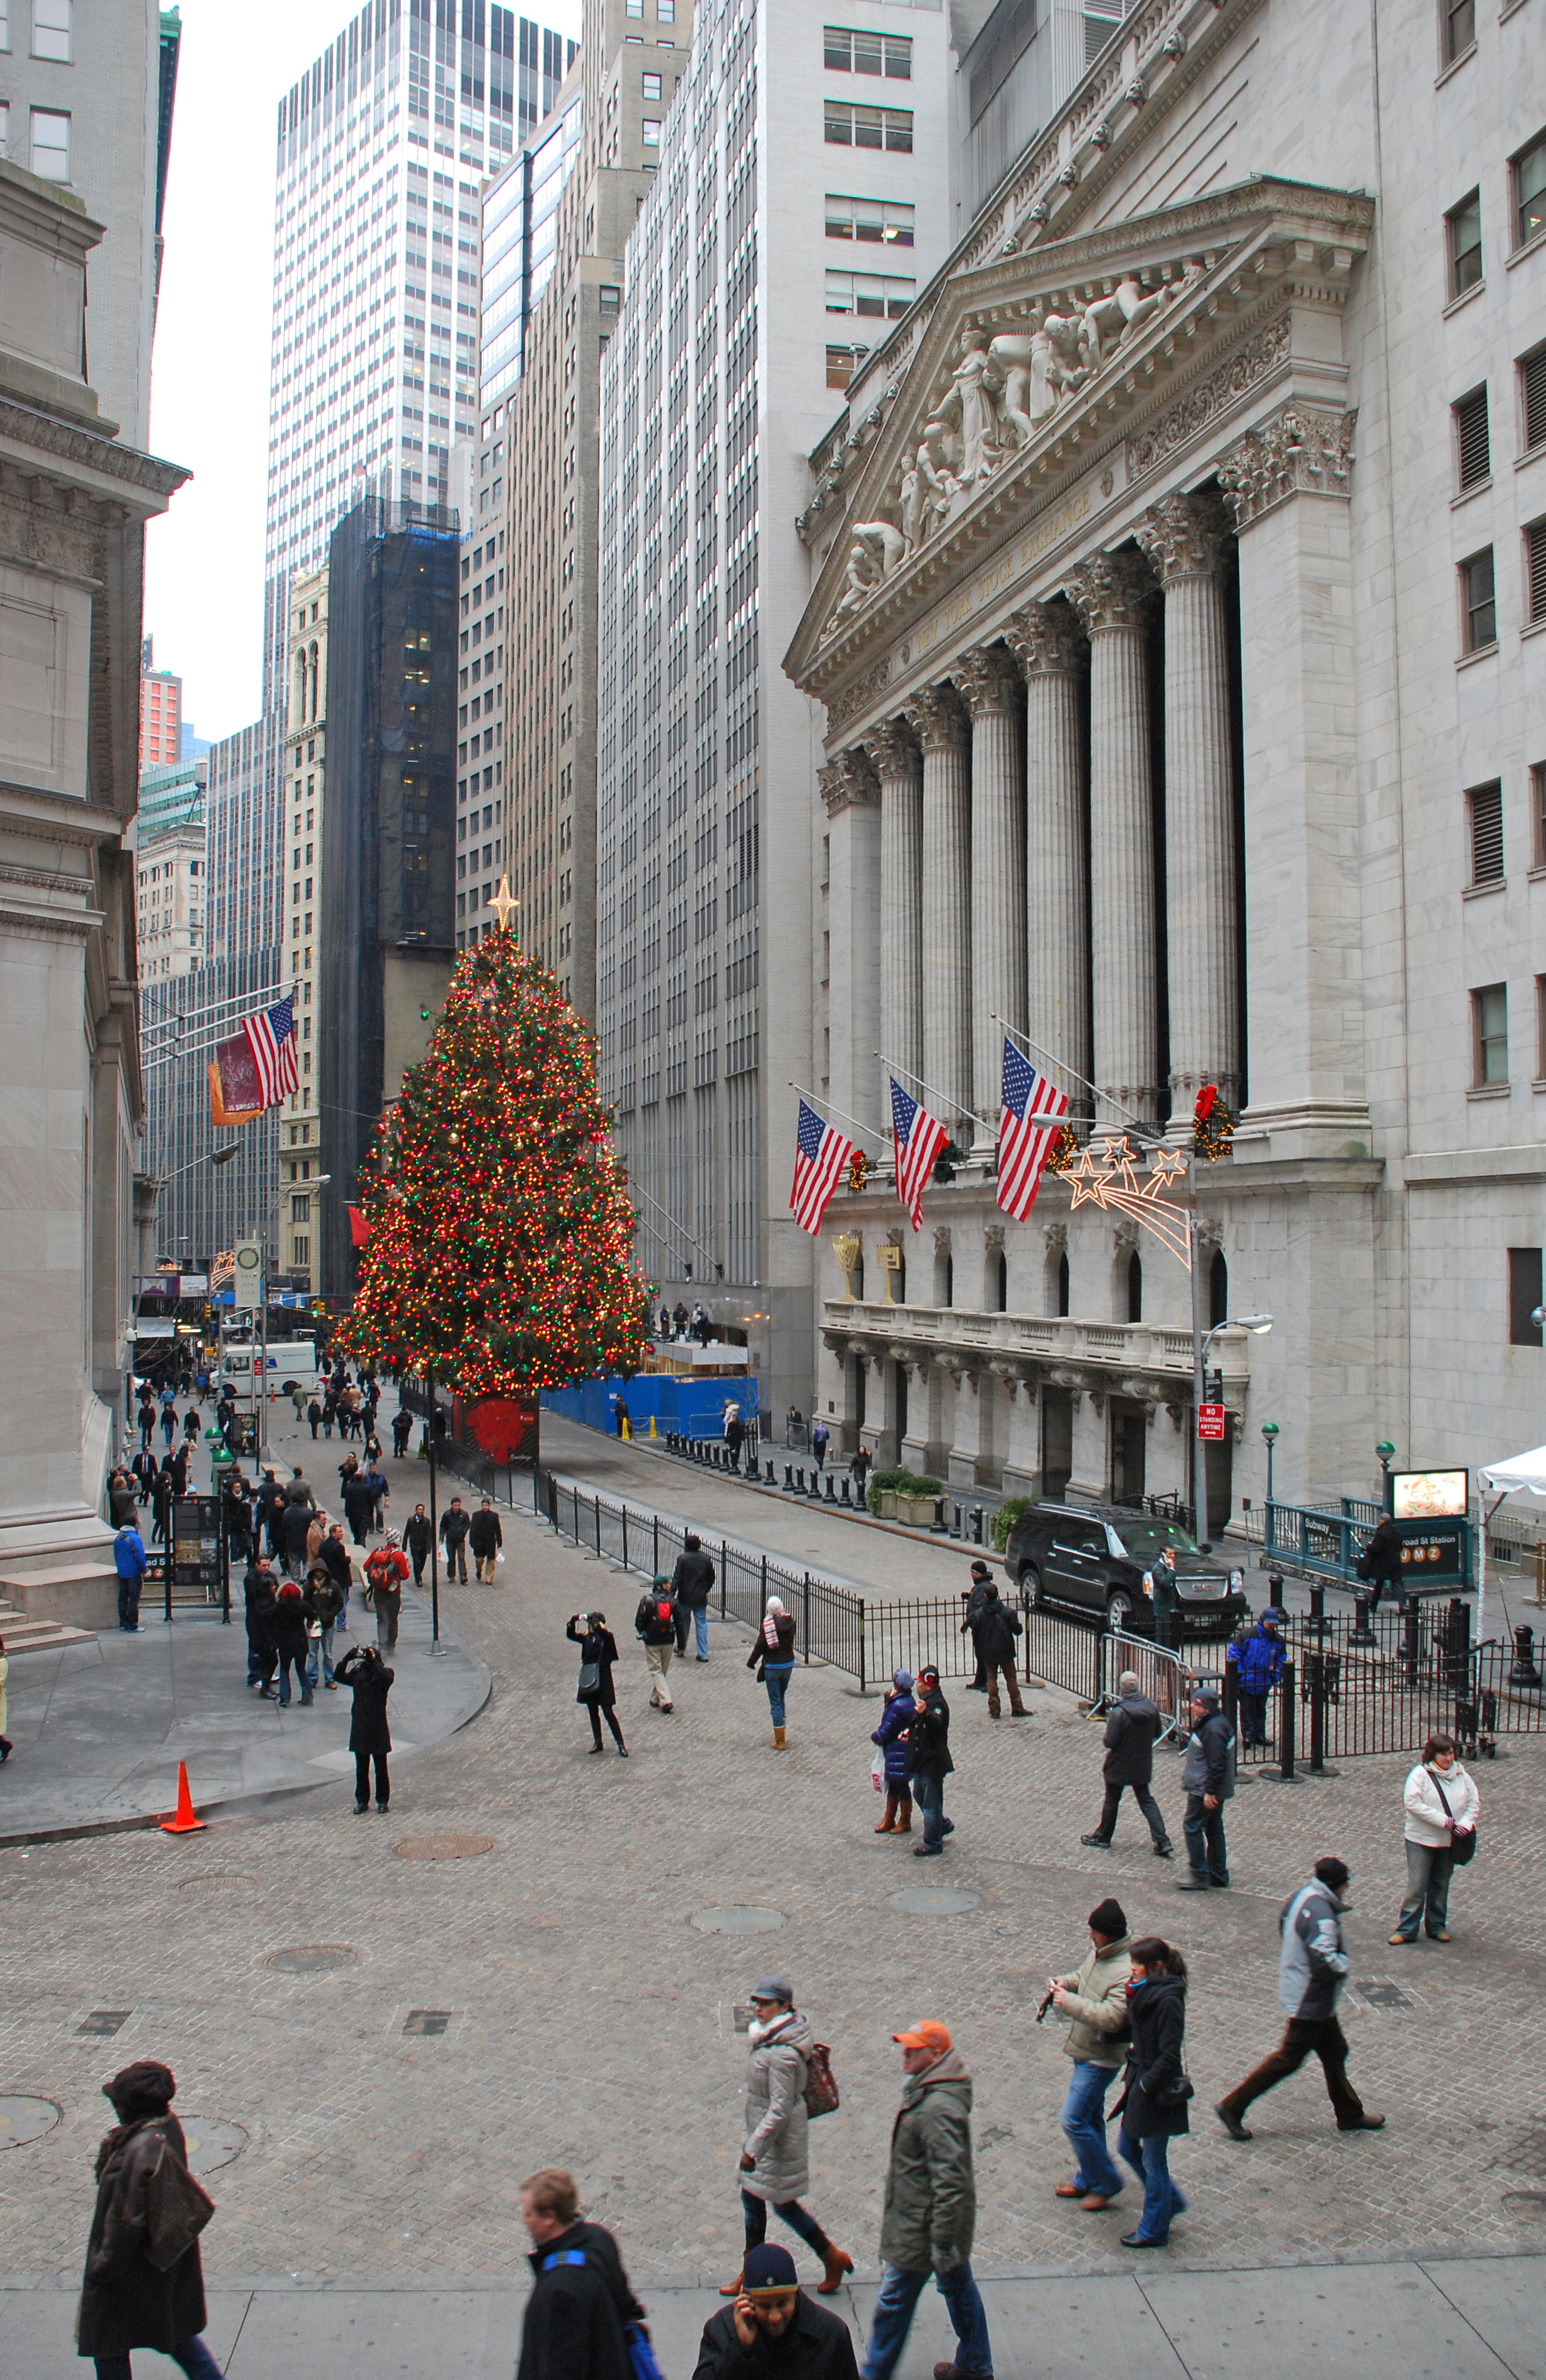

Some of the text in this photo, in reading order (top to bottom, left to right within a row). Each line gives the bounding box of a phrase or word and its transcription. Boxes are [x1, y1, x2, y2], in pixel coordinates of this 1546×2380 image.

[917, 489, 1092, 653] NEW YORK STOCK EXCHANGE
[1305, 1517, 1330, 1534] Subway
[1402, 1536, 1455, 1546] road St Station
[1401, 1548, 1437, 1560] J M Z
